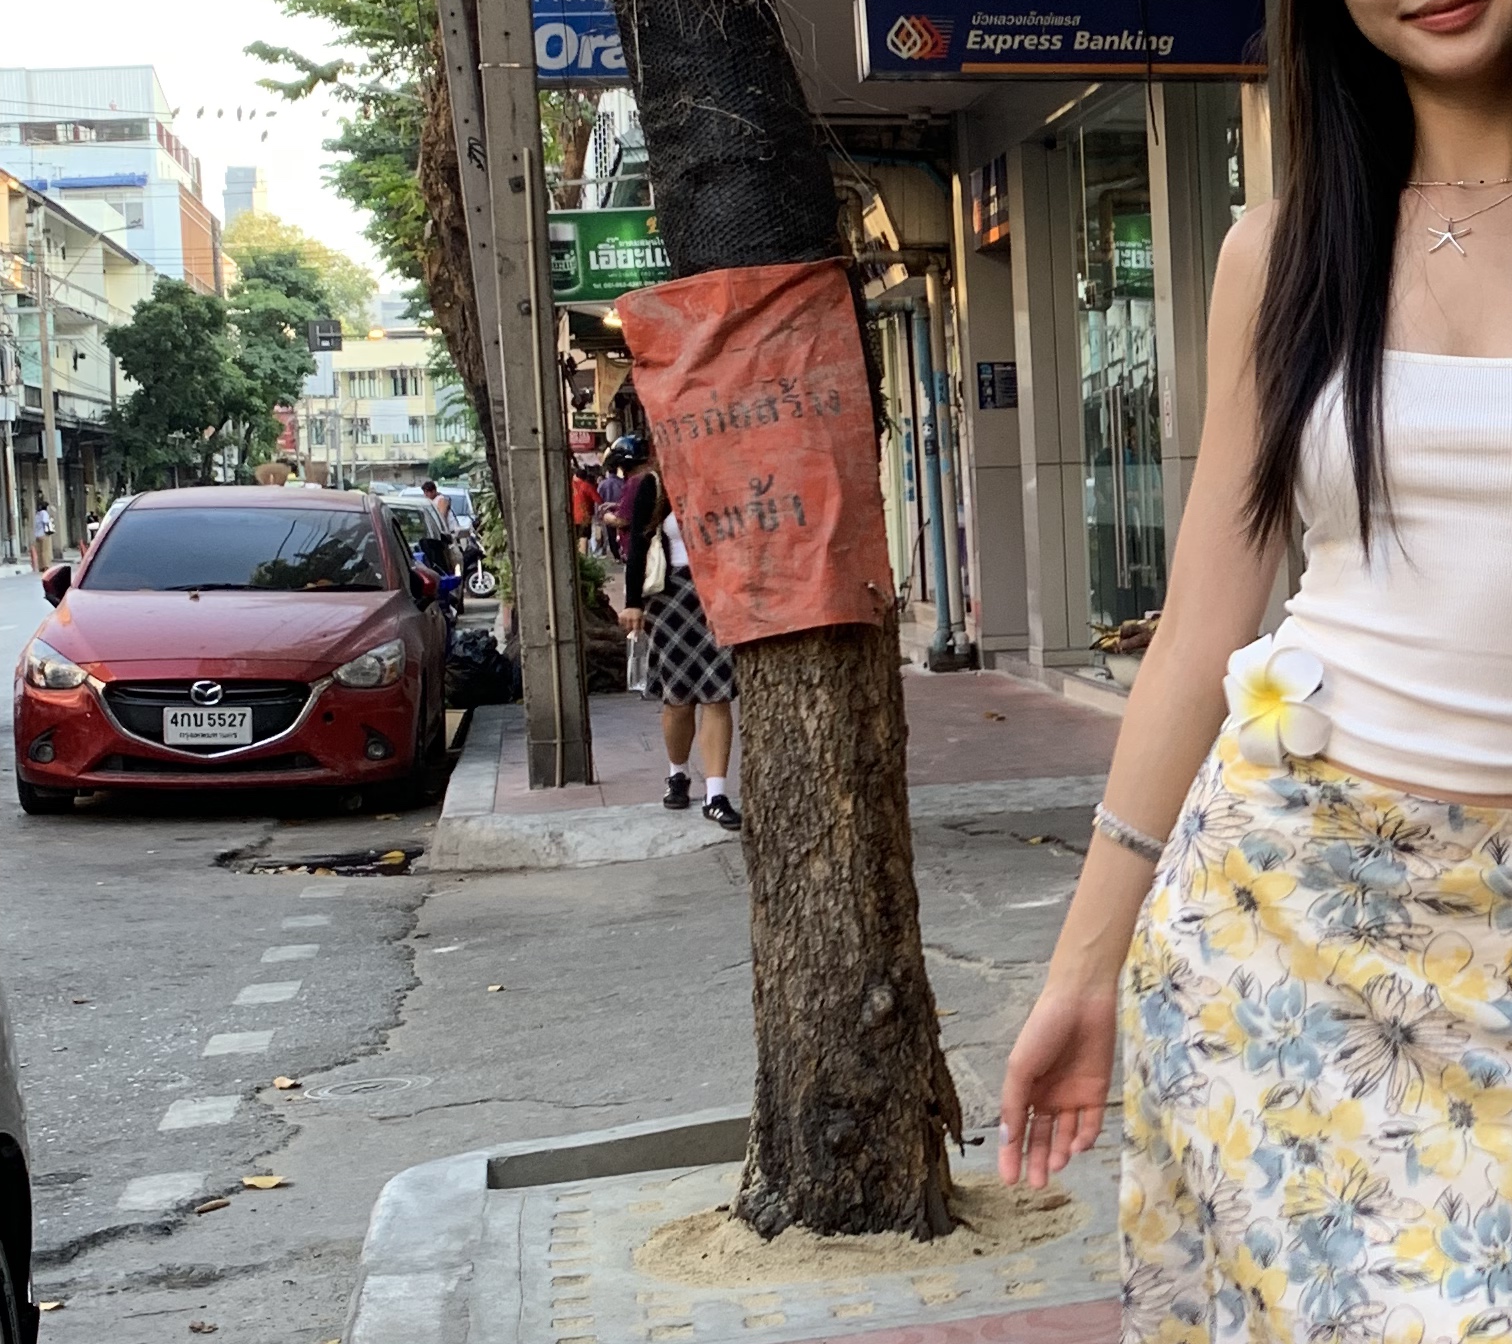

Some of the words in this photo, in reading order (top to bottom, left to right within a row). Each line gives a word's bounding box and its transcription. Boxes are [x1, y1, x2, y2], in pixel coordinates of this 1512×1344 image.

[966, 30, 1063, 54] Express
[1073, 30, 1175, 55] Banking
[207, 712, 247, 727] 5527
